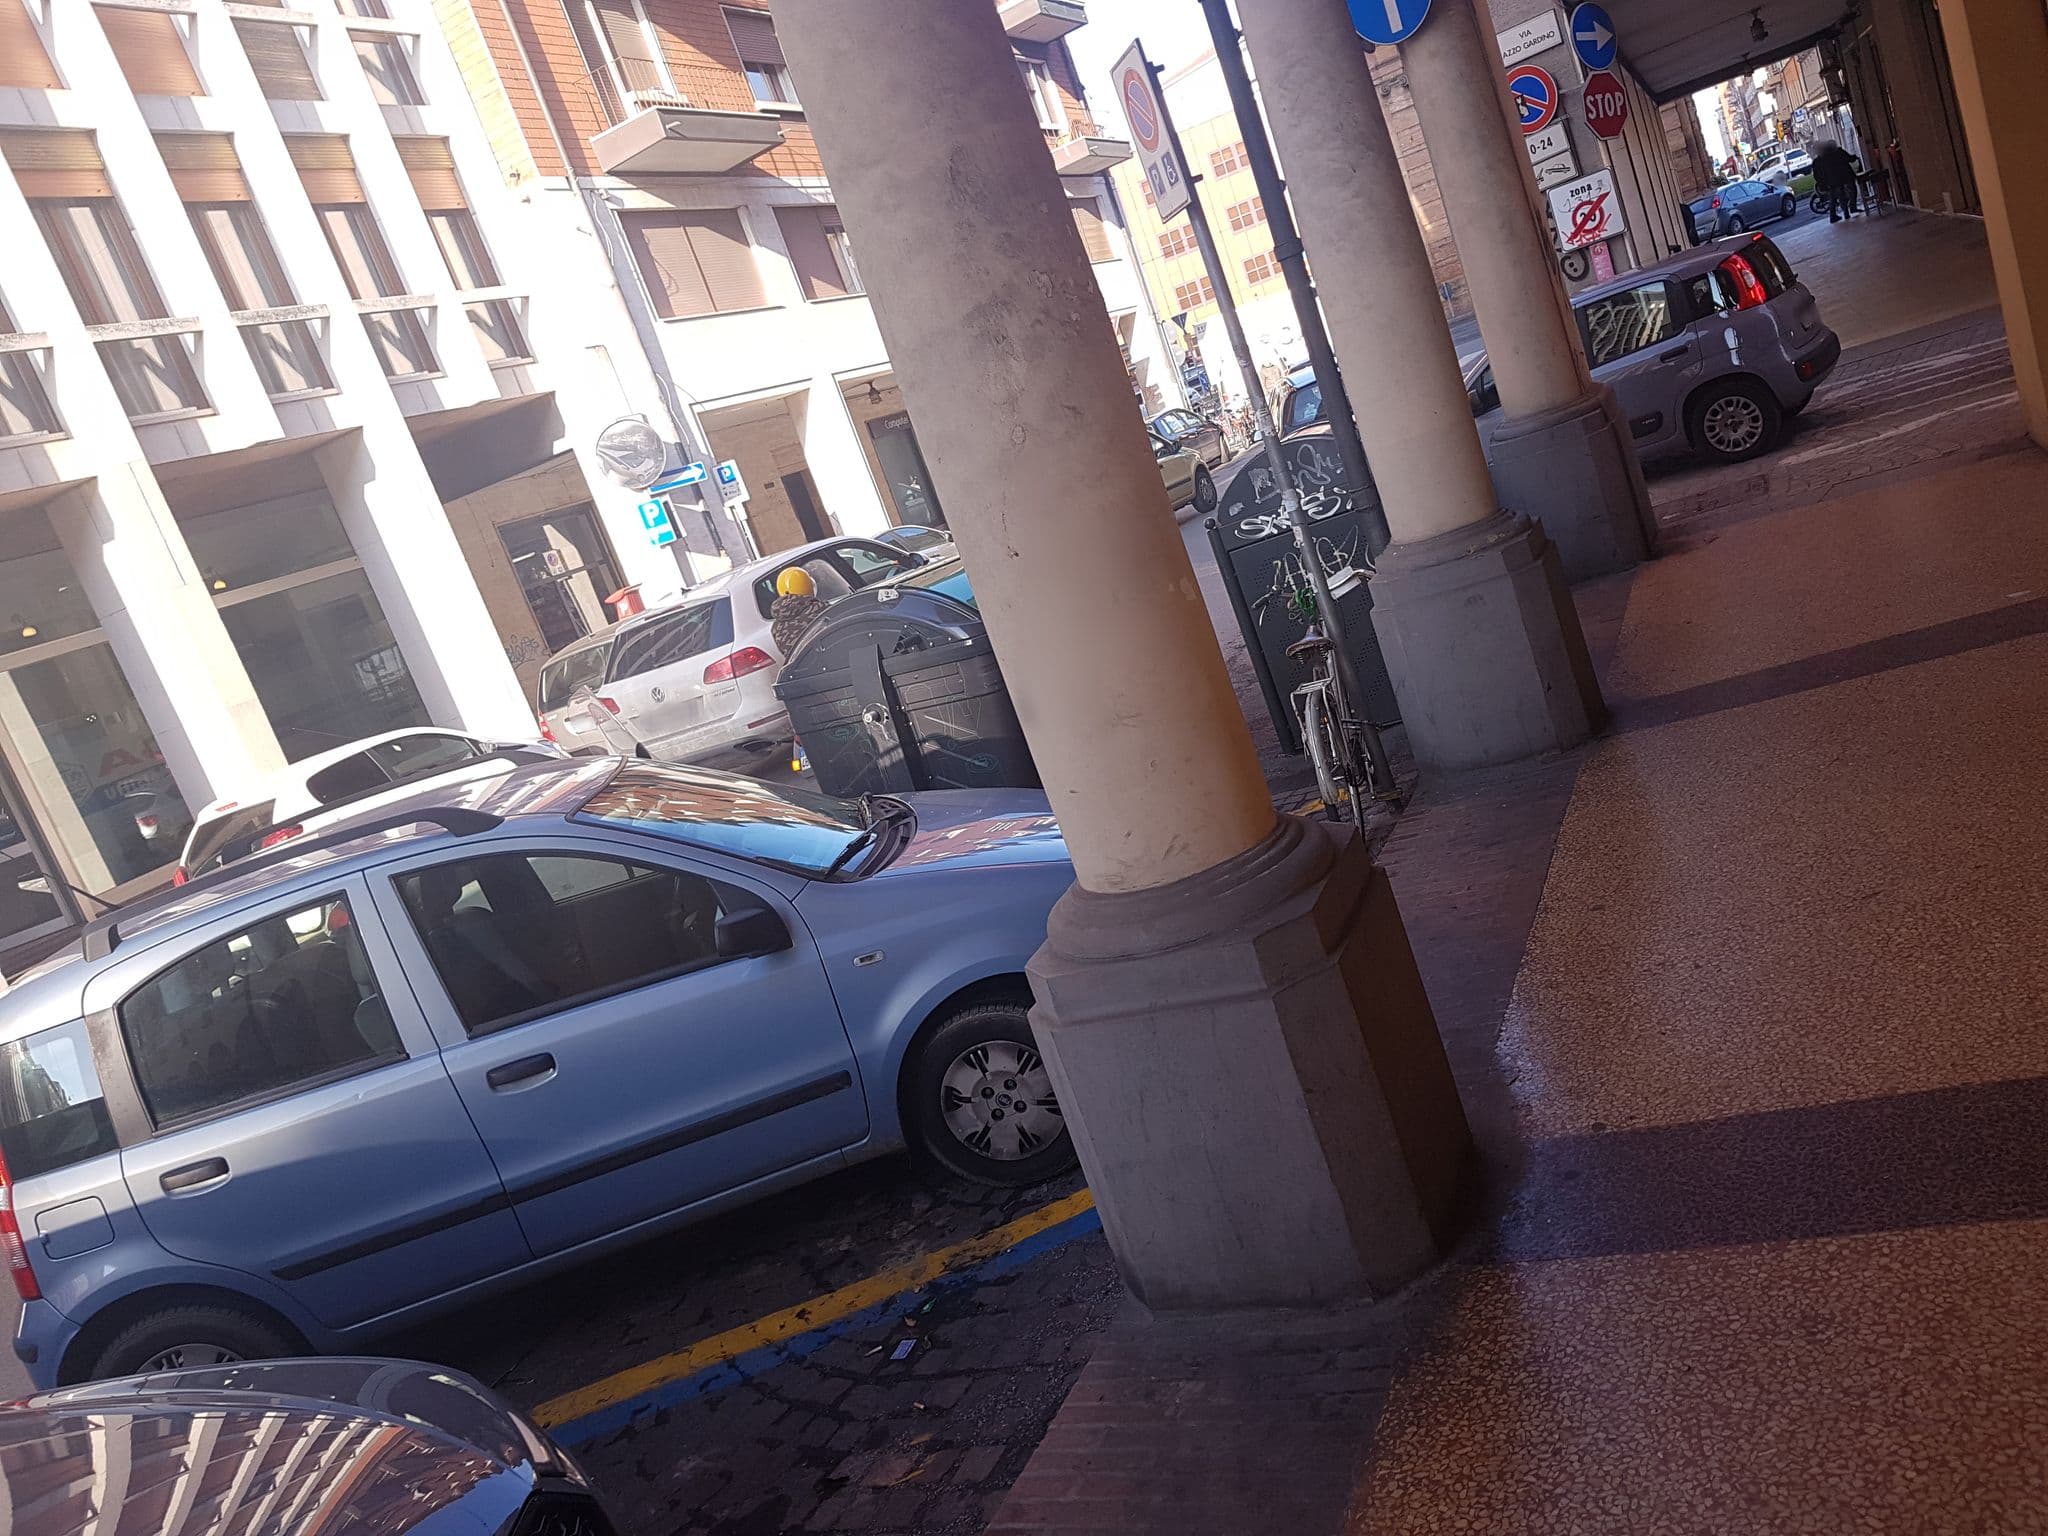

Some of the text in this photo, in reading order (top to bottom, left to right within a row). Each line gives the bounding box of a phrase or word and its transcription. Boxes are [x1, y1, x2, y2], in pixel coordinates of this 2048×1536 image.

[1519, 29, 1532, 39] VIA
[1502, 30, 1555, 58] AZZO GARDINO
[1586, 91, 1624, 120] STOP
[1529, 136, 1553, 154] 0-24
[1569, 183, 1593, 198] zona
[720, 466, 733, 482] P
[645, 501, 660, 528] P
